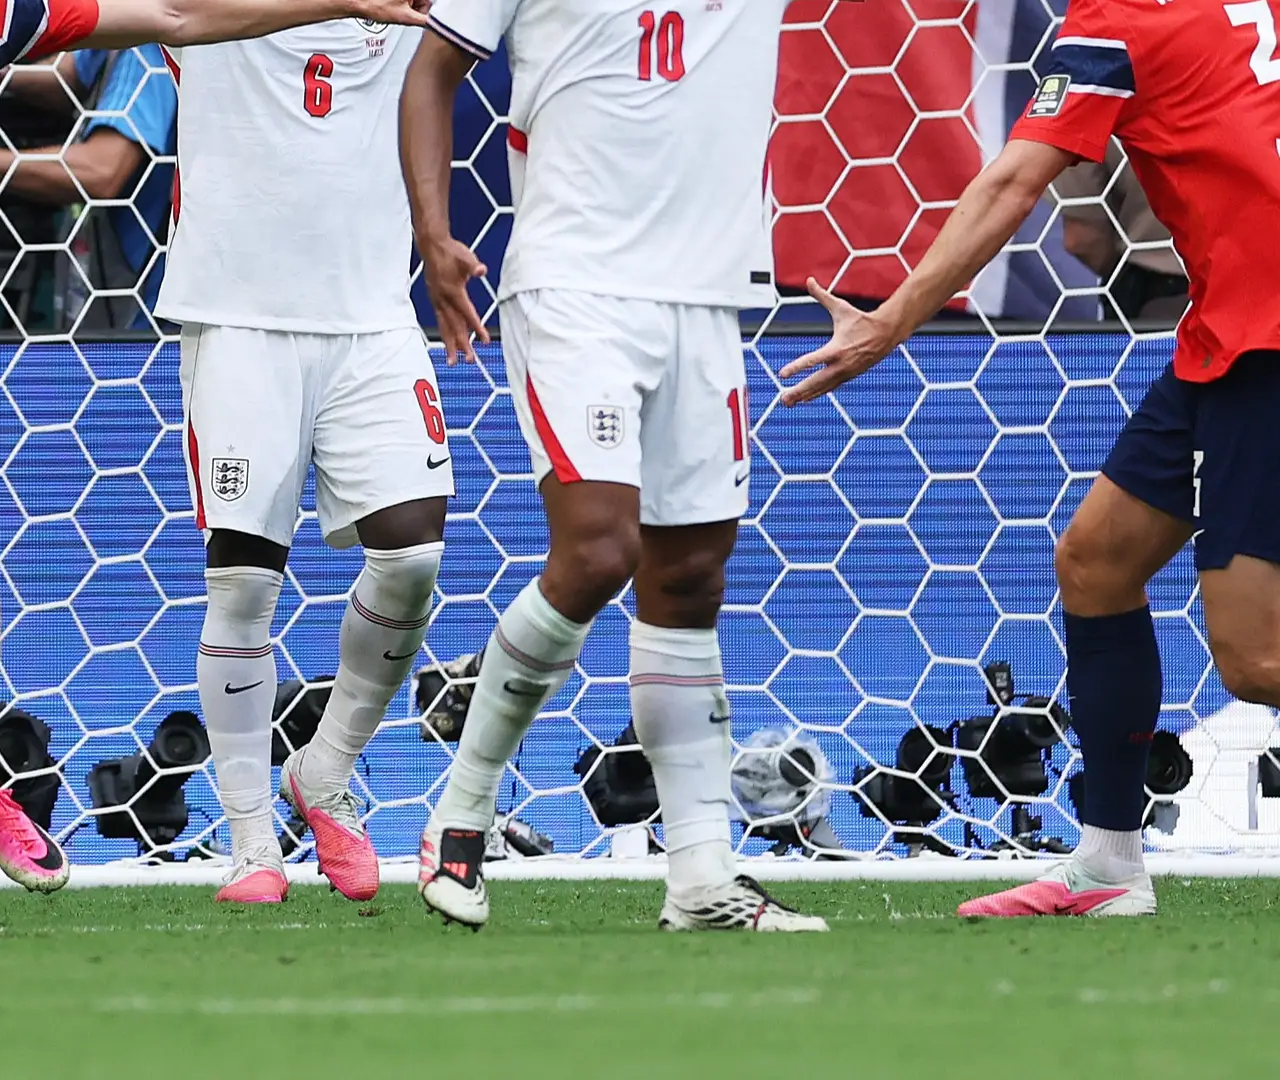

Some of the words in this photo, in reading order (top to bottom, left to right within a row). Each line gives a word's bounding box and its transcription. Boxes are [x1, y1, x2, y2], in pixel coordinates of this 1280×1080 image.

[637, 10, 685, 82] 10
[303, 52, 334, 118] 6
[413, 378, 446, 444] 6
[727, 387, 751, 461] 1
